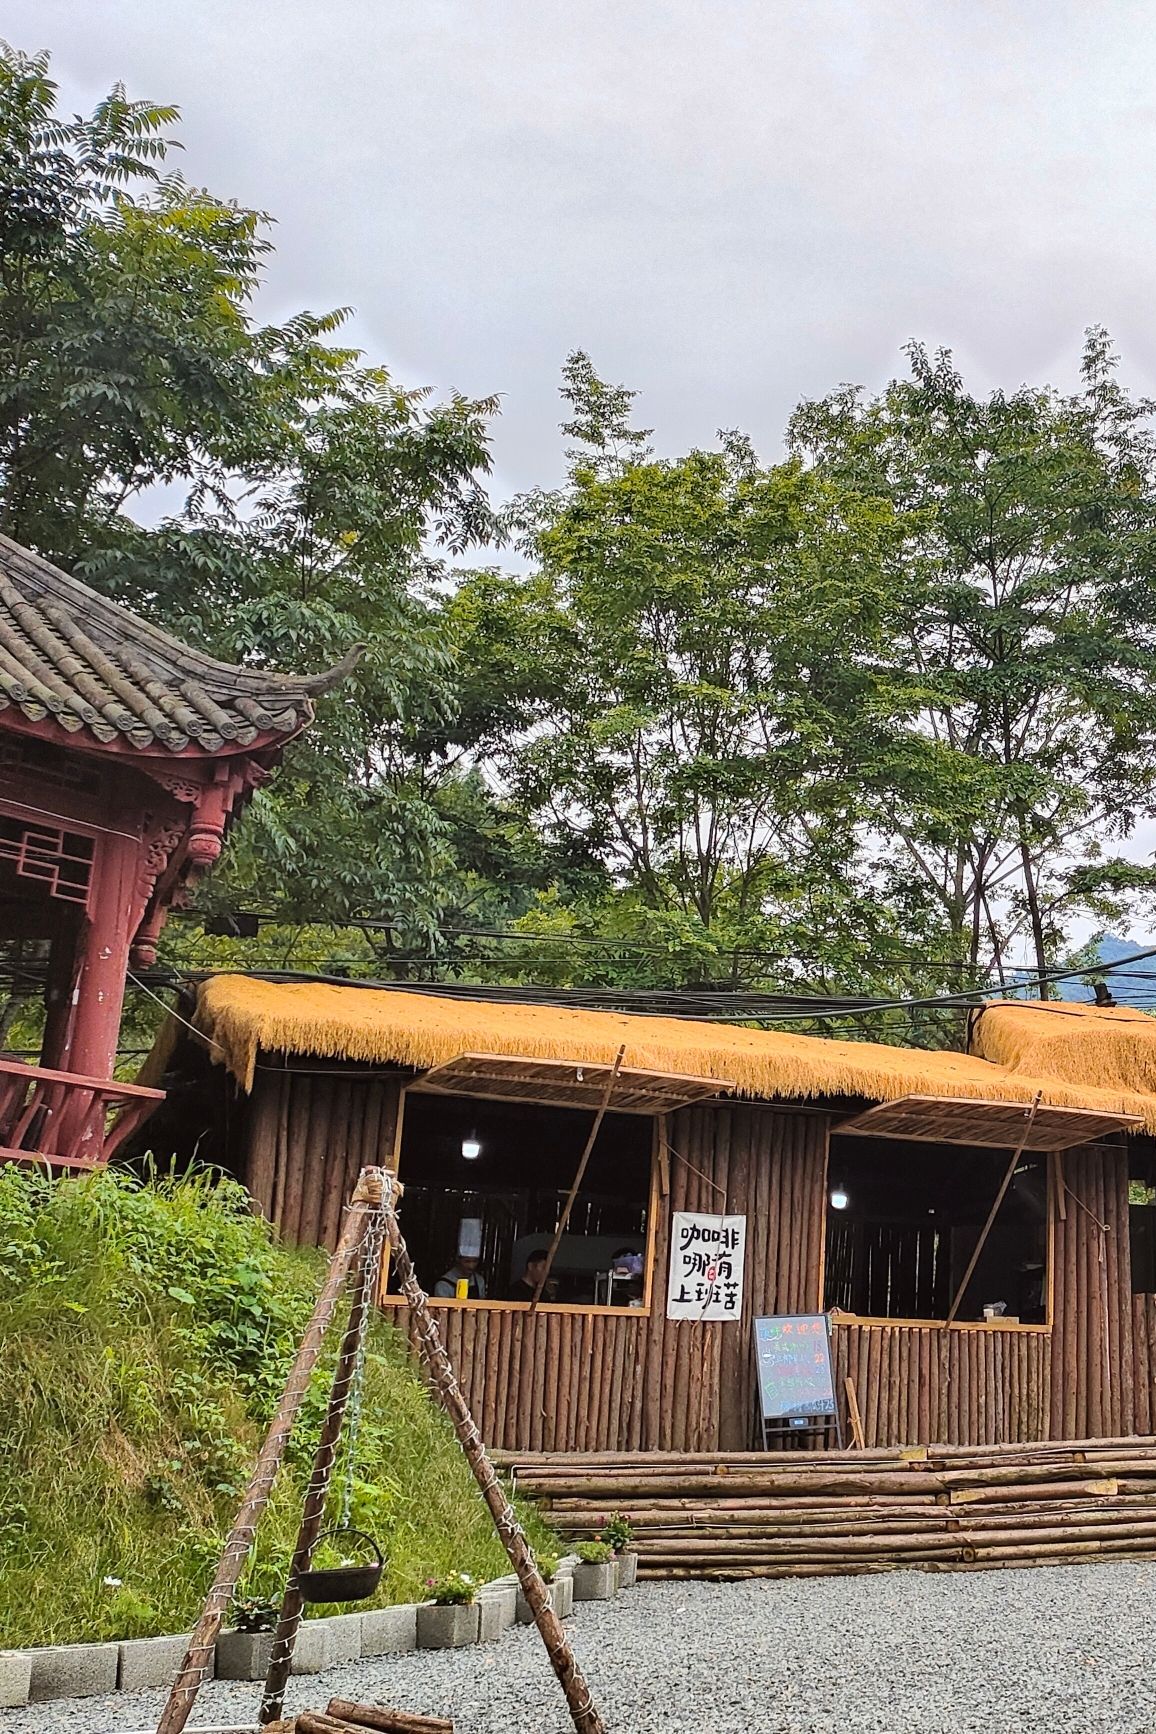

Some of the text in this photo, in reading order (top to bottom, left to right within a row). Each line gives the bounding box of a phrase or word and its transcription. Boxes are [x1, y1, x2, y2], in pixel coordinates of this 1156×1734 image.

[680, 1223, 740, 1251] 咖啡
[682, 1250, 733, 1280] 哪有
[672, 1281, 739, 1310] 上班苦
